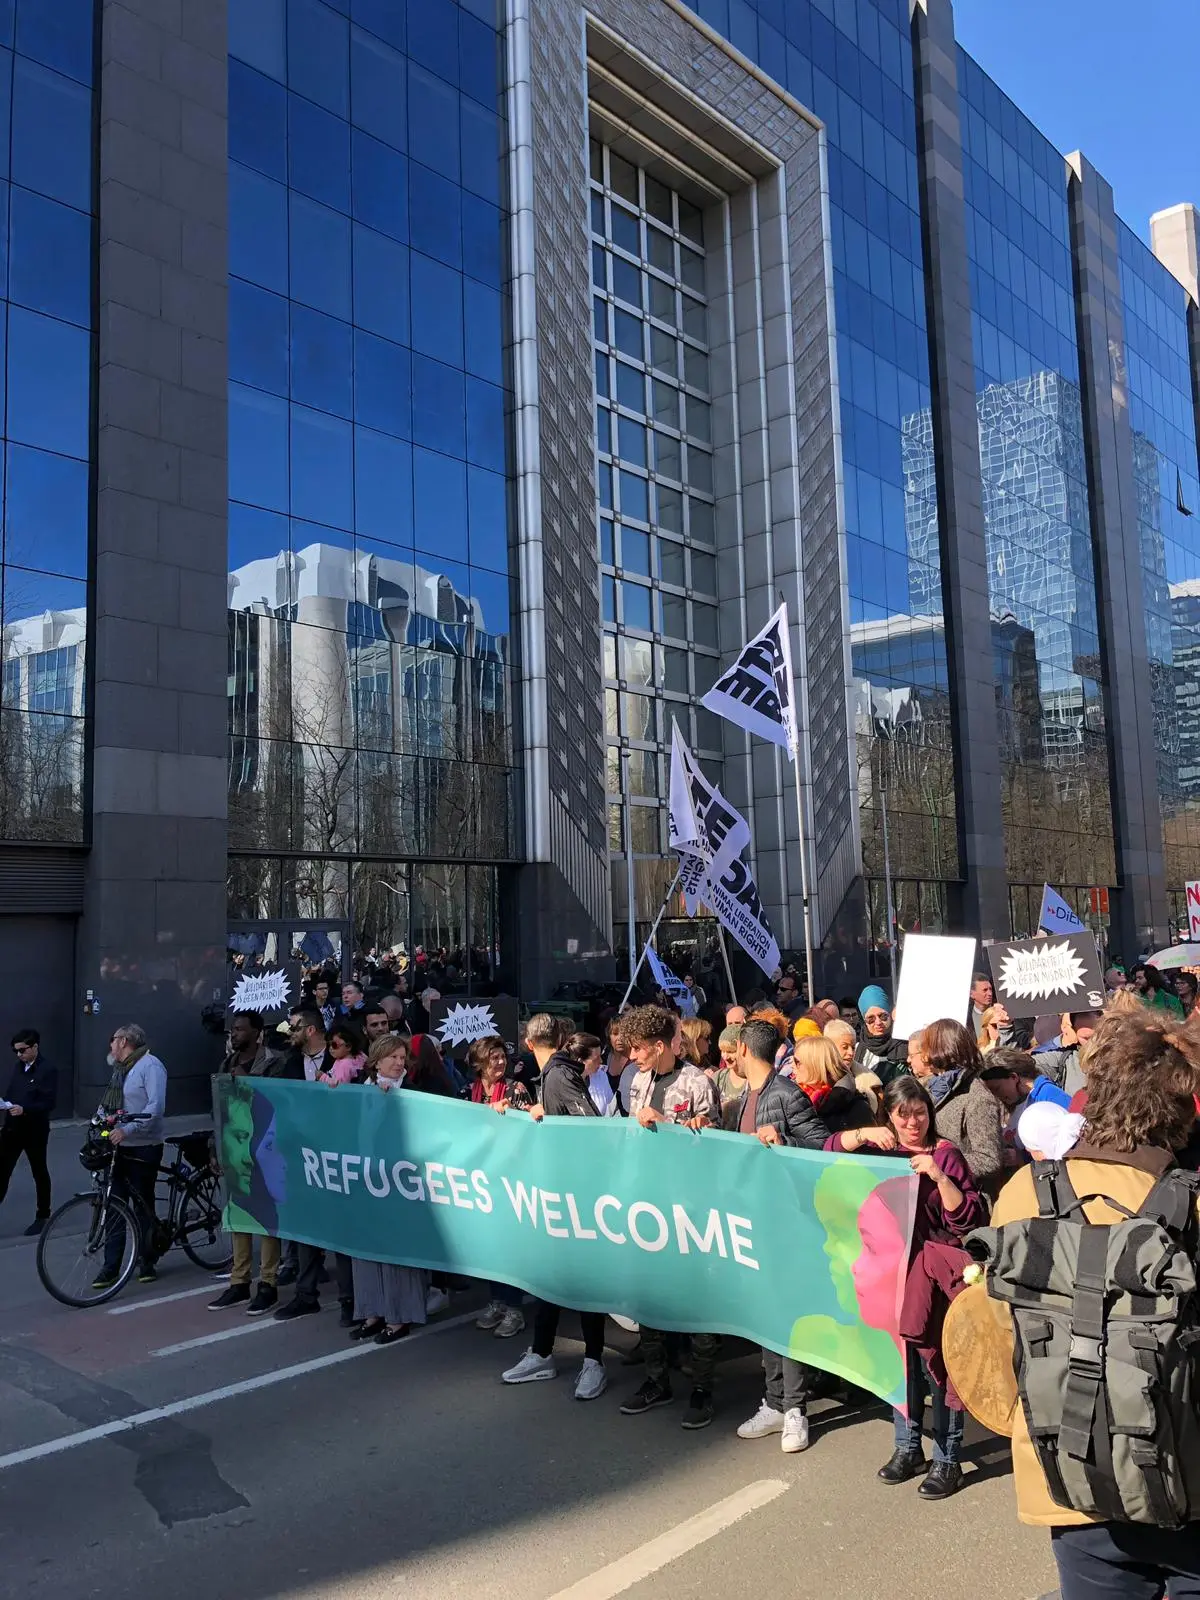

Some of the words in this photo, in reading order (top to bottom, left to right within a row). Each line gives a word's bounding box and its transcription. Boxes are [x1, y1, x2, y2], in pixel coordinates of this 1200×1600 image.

[712, 884, 734, 911] NIMAL
[734, 906, 771, 951] LIBERATION
[738, 925, 768, 960] RIGHTS
[1020, 971, 1040, 986] GEEN
[454, 1016, 470, 1026] NIET
[471, 1014, 480, 1023] IN
[466, 1021, 491, 1034] NAAM
[301, 1146, 493, 1214] REFUGEES
[502, 1175, 761, 1272] WELCOME
